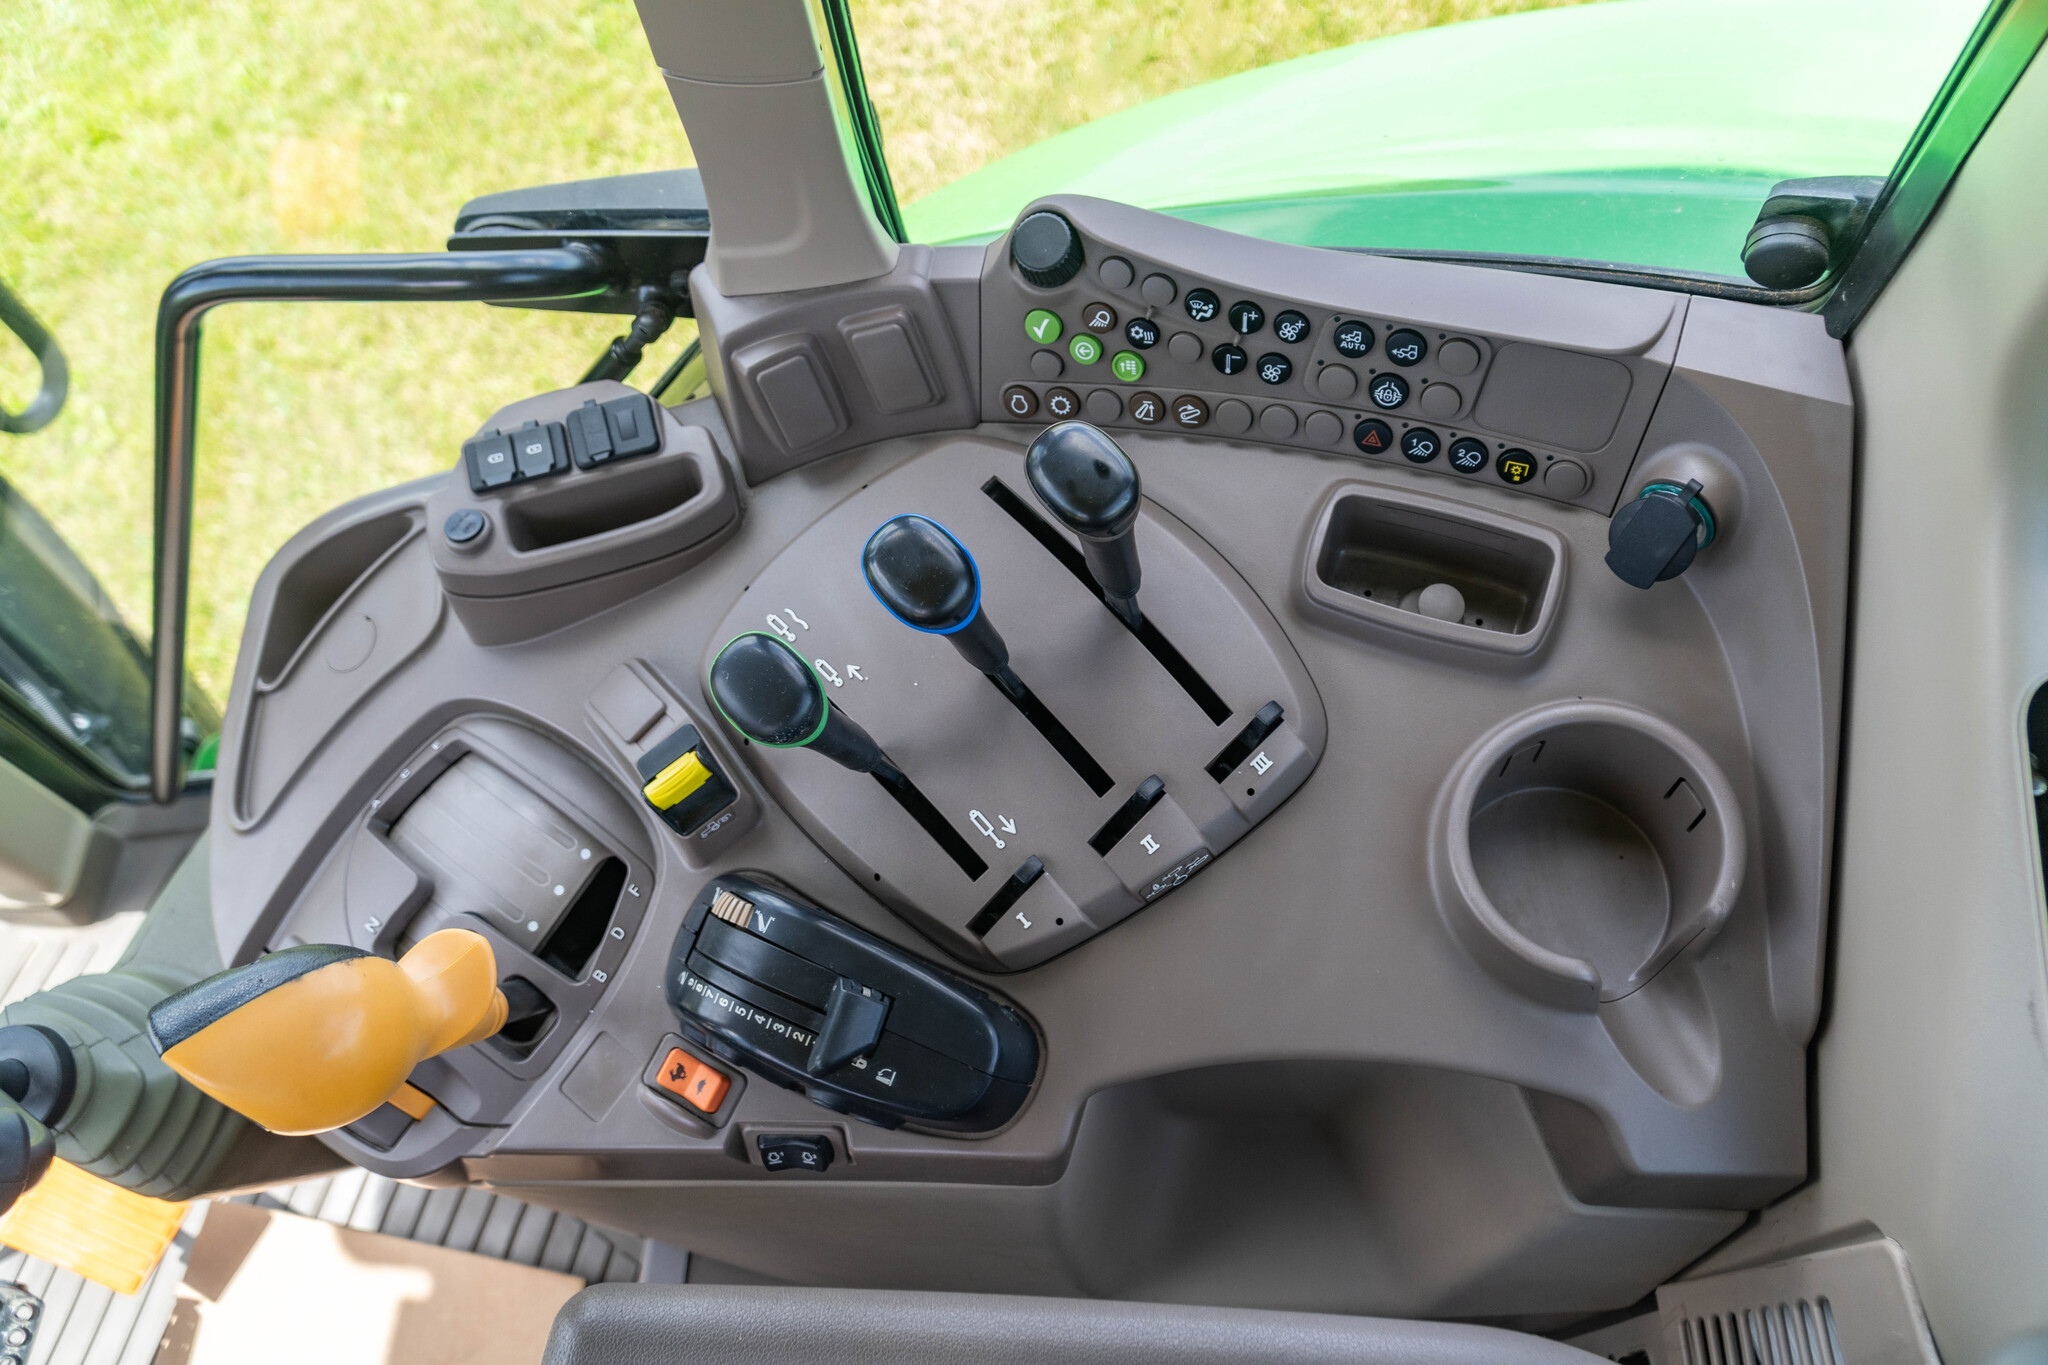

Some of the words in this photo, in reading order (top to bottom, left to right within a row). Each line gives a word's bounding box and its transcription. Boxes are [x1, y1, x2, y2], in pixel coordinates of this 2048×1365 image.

[1340, 341, 1366, 351] AUTO
[1411, 438, 1417, 447] 1
[1458, 449, 1465, 458] 2
[627, 883, 640, 897] F
[364, 915, 380, 933] N
[610, 926, 626, 941] D
[592, 969, 608, 983] B
[696, 983, 703, 993] 8
[705, 988, 714, 999] 7
[719, 996, 729, 1007] 6
[735, 1005, 747, 1017] 5
[754, 1014, 766, 1025] 4
[772, 1022, 785, 1033] 3
[792, 1031, 805, 1043] 2
